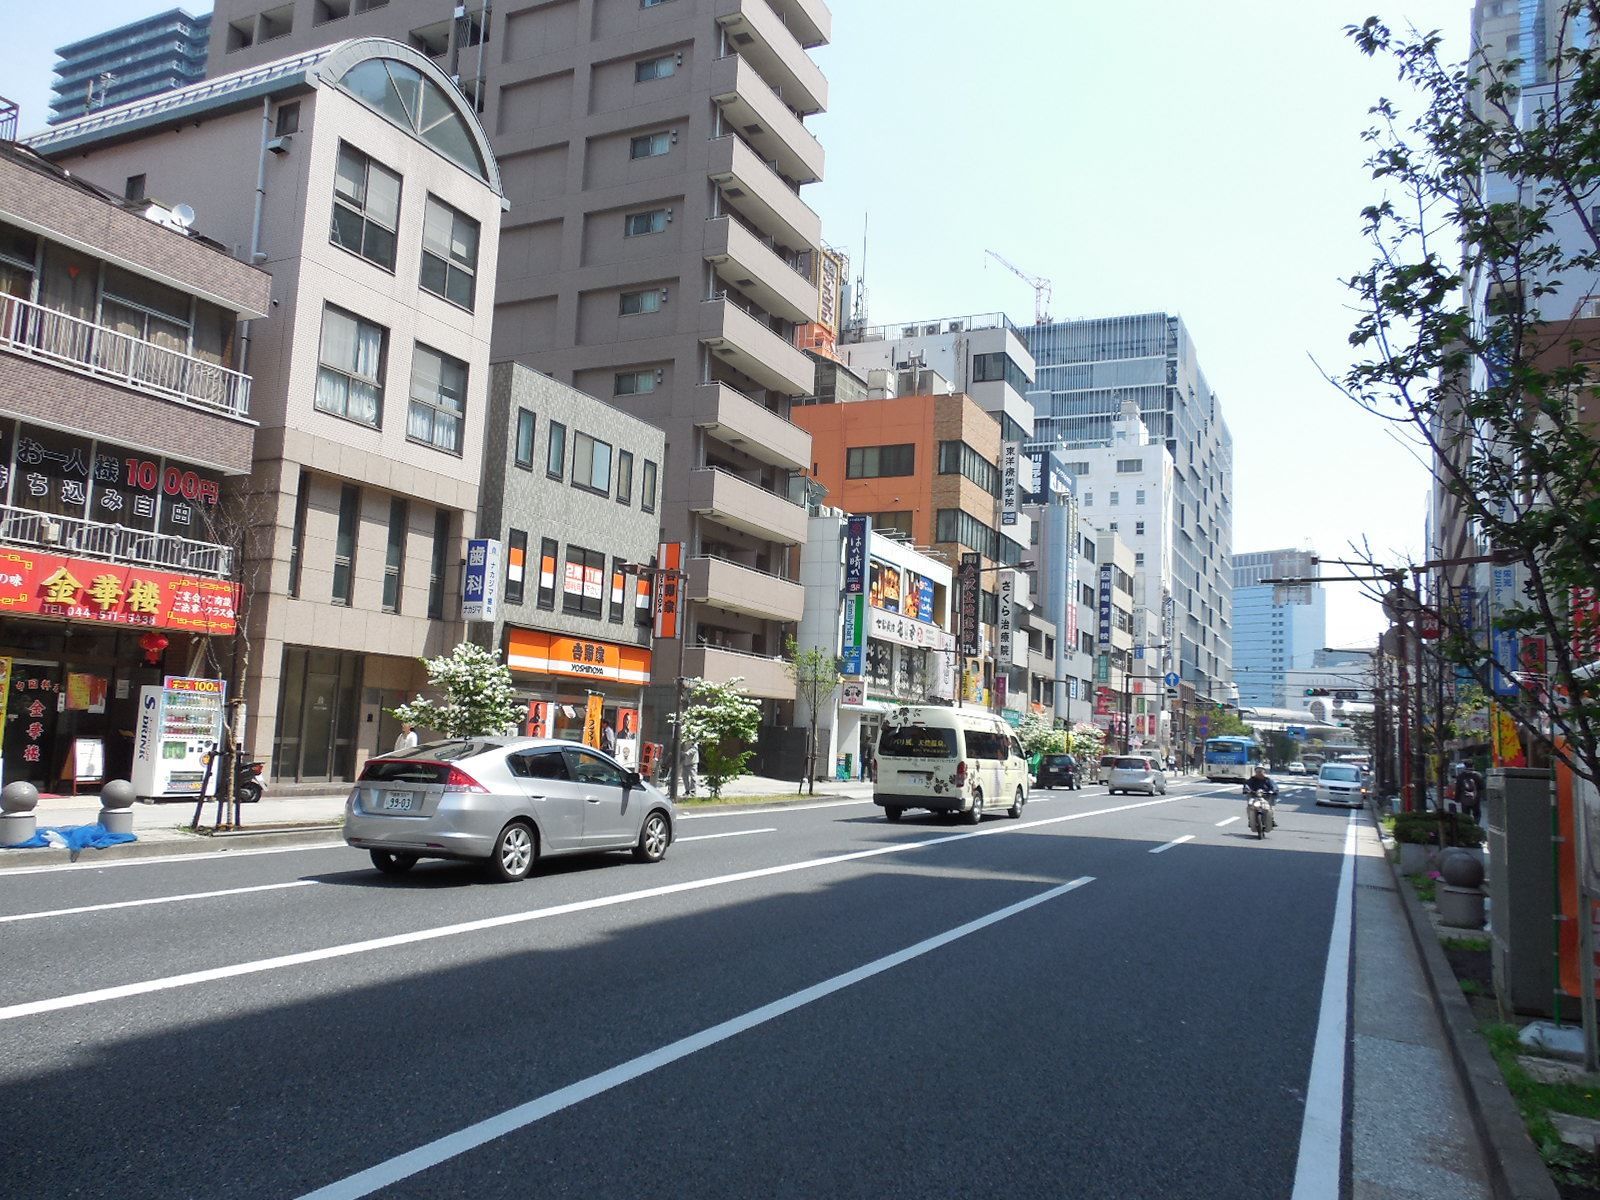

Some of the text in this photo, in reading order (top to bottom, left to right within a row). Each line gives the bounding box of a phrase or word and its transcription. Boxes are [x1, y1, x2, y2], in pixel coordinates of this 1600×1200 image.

[41, 566, 161, 614] 金華楼
[467, 546, 485, 595] 歯科
[44, 604, 65, 615] TEL
[846, 600, 854, 640] FamilyMart
[1001, 581, 1011, 656] さくら治療院
[571, 664, 604, 675] YOSHINOYA
[572, 643, 605, 663] 吉野家
